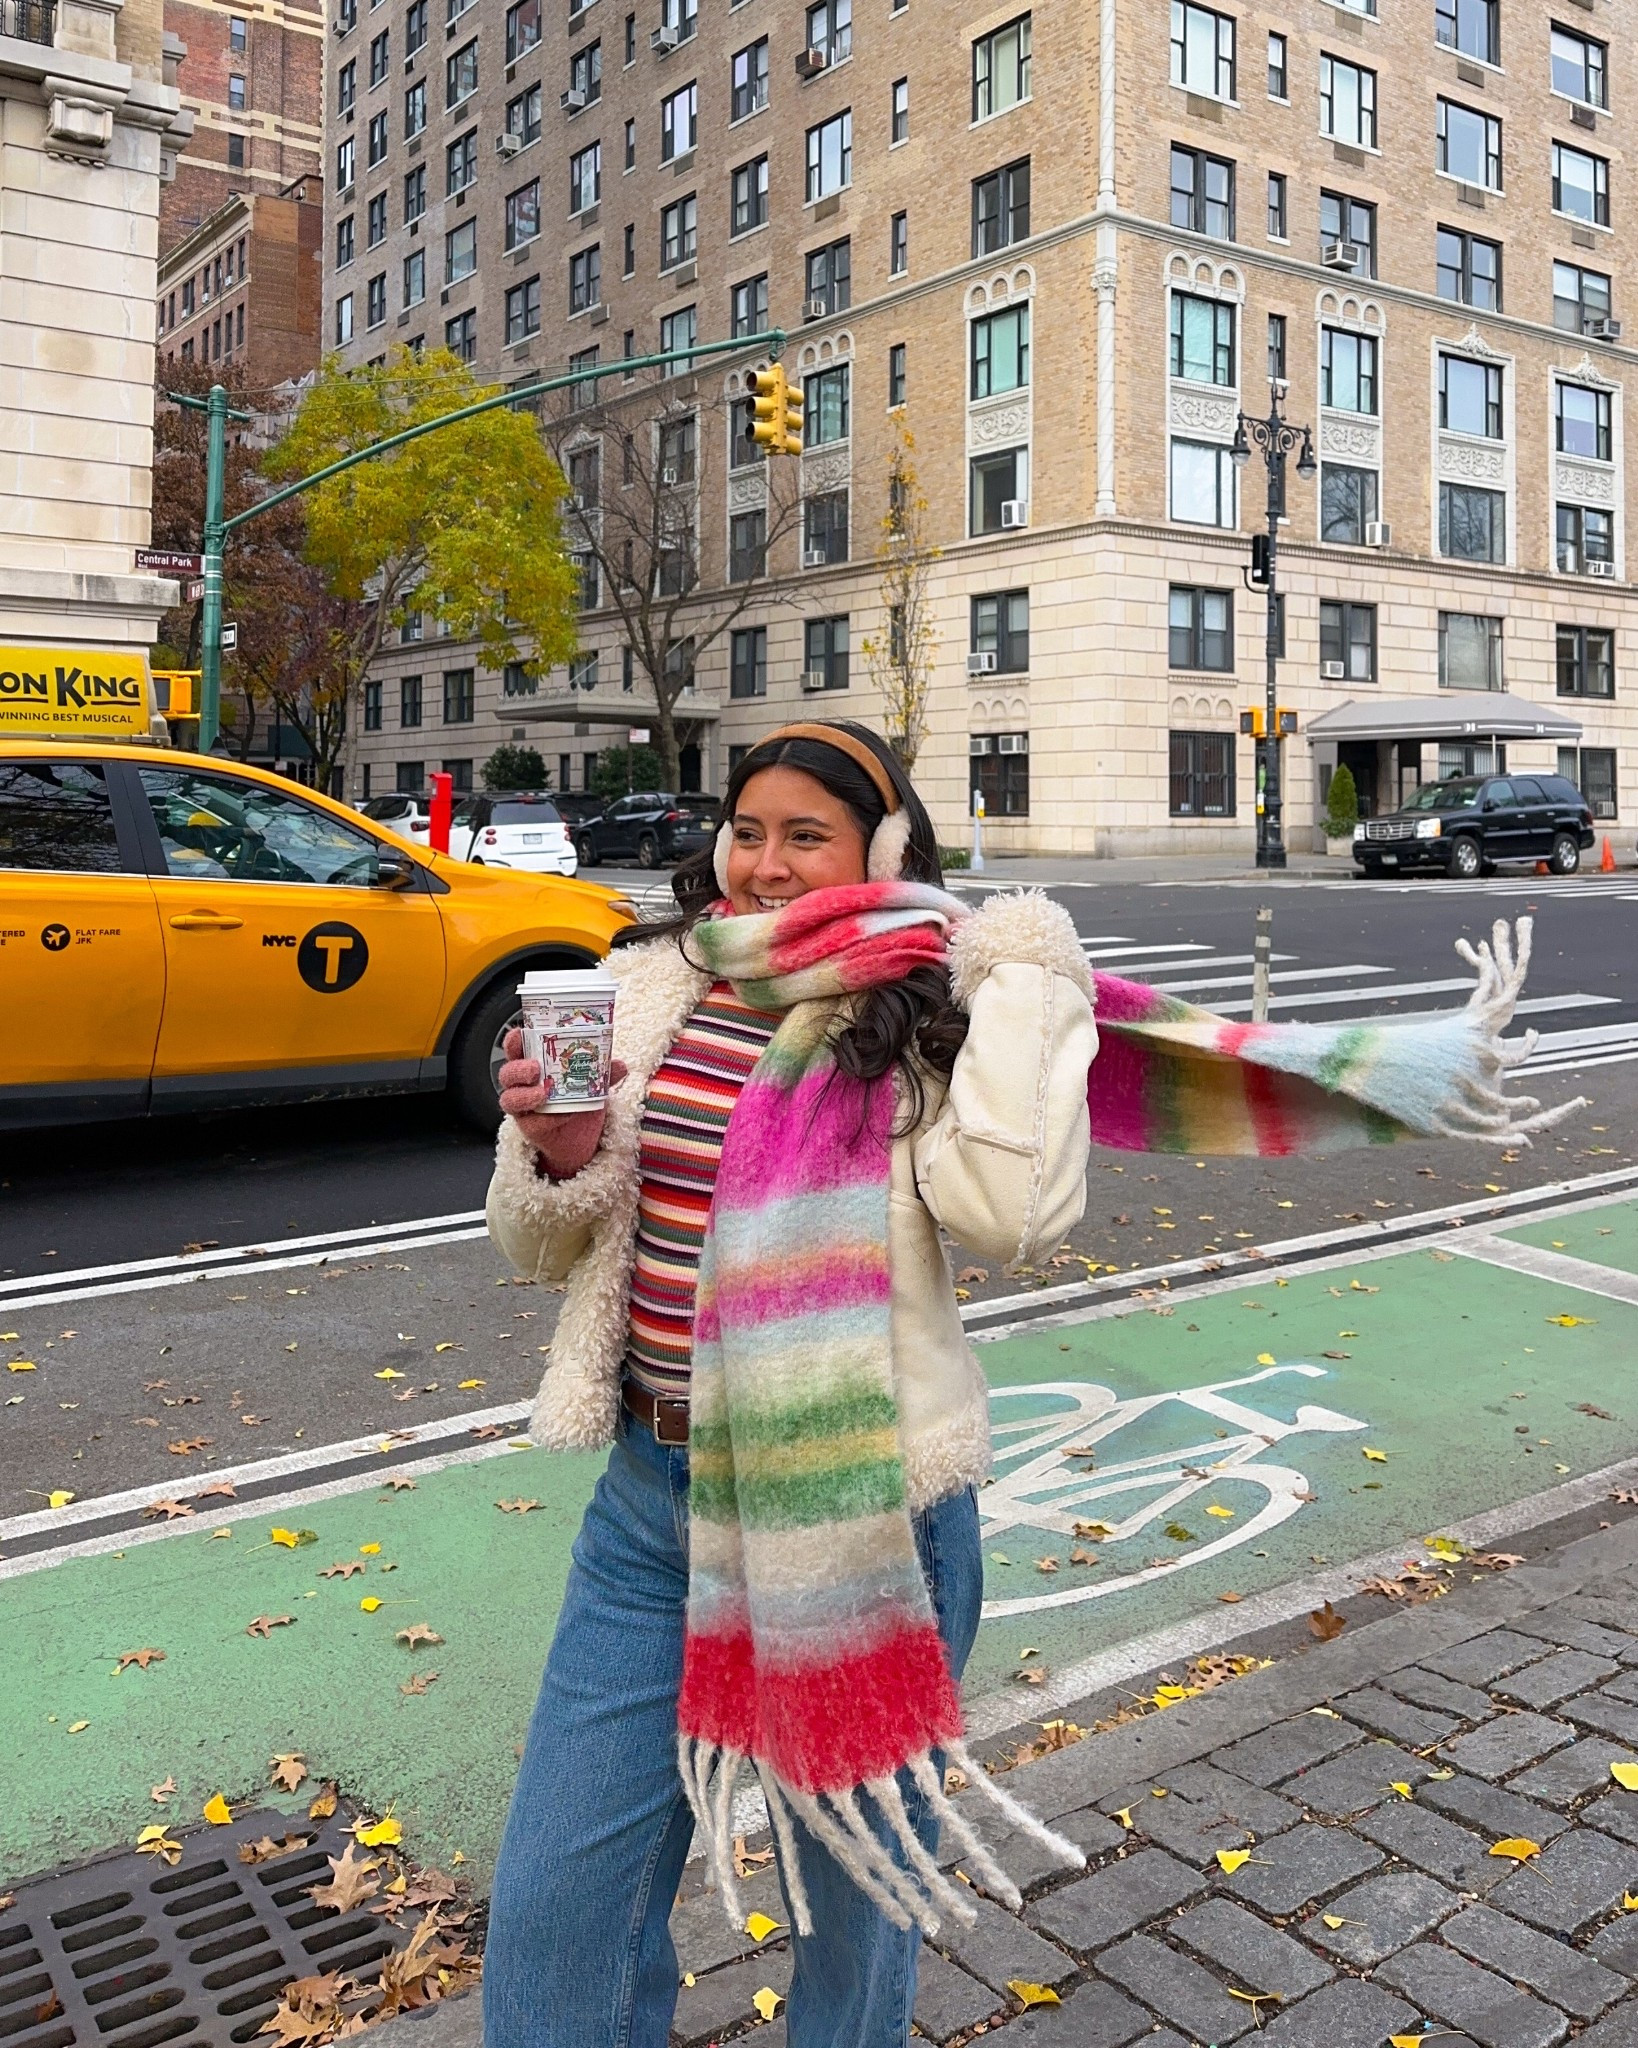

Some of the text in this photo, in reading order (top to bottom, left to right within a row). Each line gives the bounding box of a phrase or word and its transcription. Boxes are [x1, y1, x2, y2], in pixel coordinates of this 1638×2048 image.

[137, 553, 193, 567] Central Park
[52, 713, 80, 722] BEST
[82, 714, 133, 724] MUSICAL
[0, 930, 26, 938] ERED
[98, 928, 121, 936] FARE
[75, 937, 92, 945] JFK
[262, 934, 354, 984] NYC T
